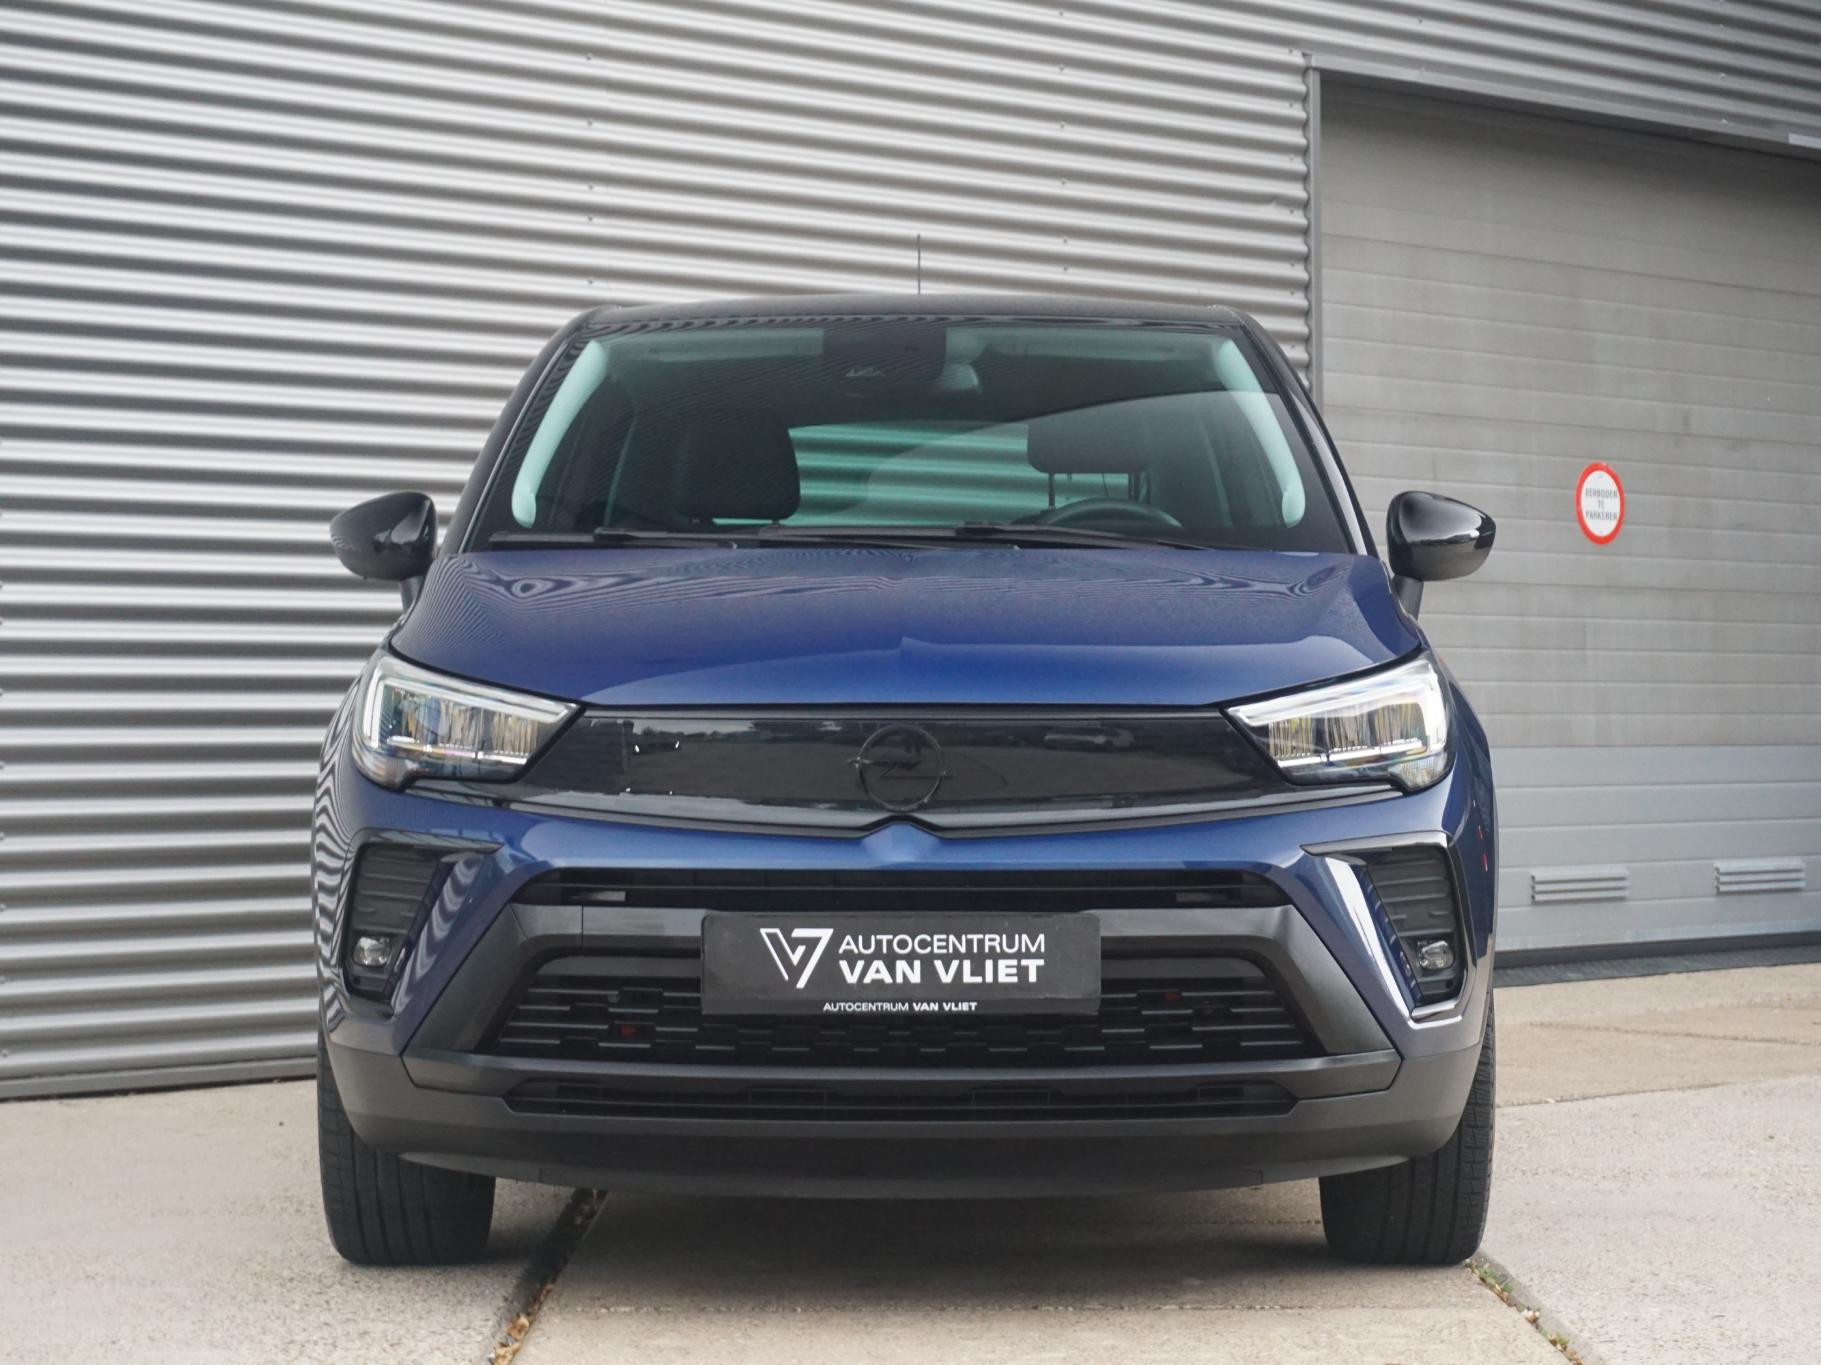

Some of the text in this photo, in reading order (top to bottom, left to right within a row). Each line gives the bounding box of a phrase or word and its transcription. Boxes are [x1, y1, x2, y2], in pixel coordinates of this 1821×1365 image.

[838, 933, 1045, 955] AUTOCENTRUM
[839, 958, 1045, 984] VAN VLIET
[823, 1002, 978, 1012] AUTOCENTRUM VAN VLIET
